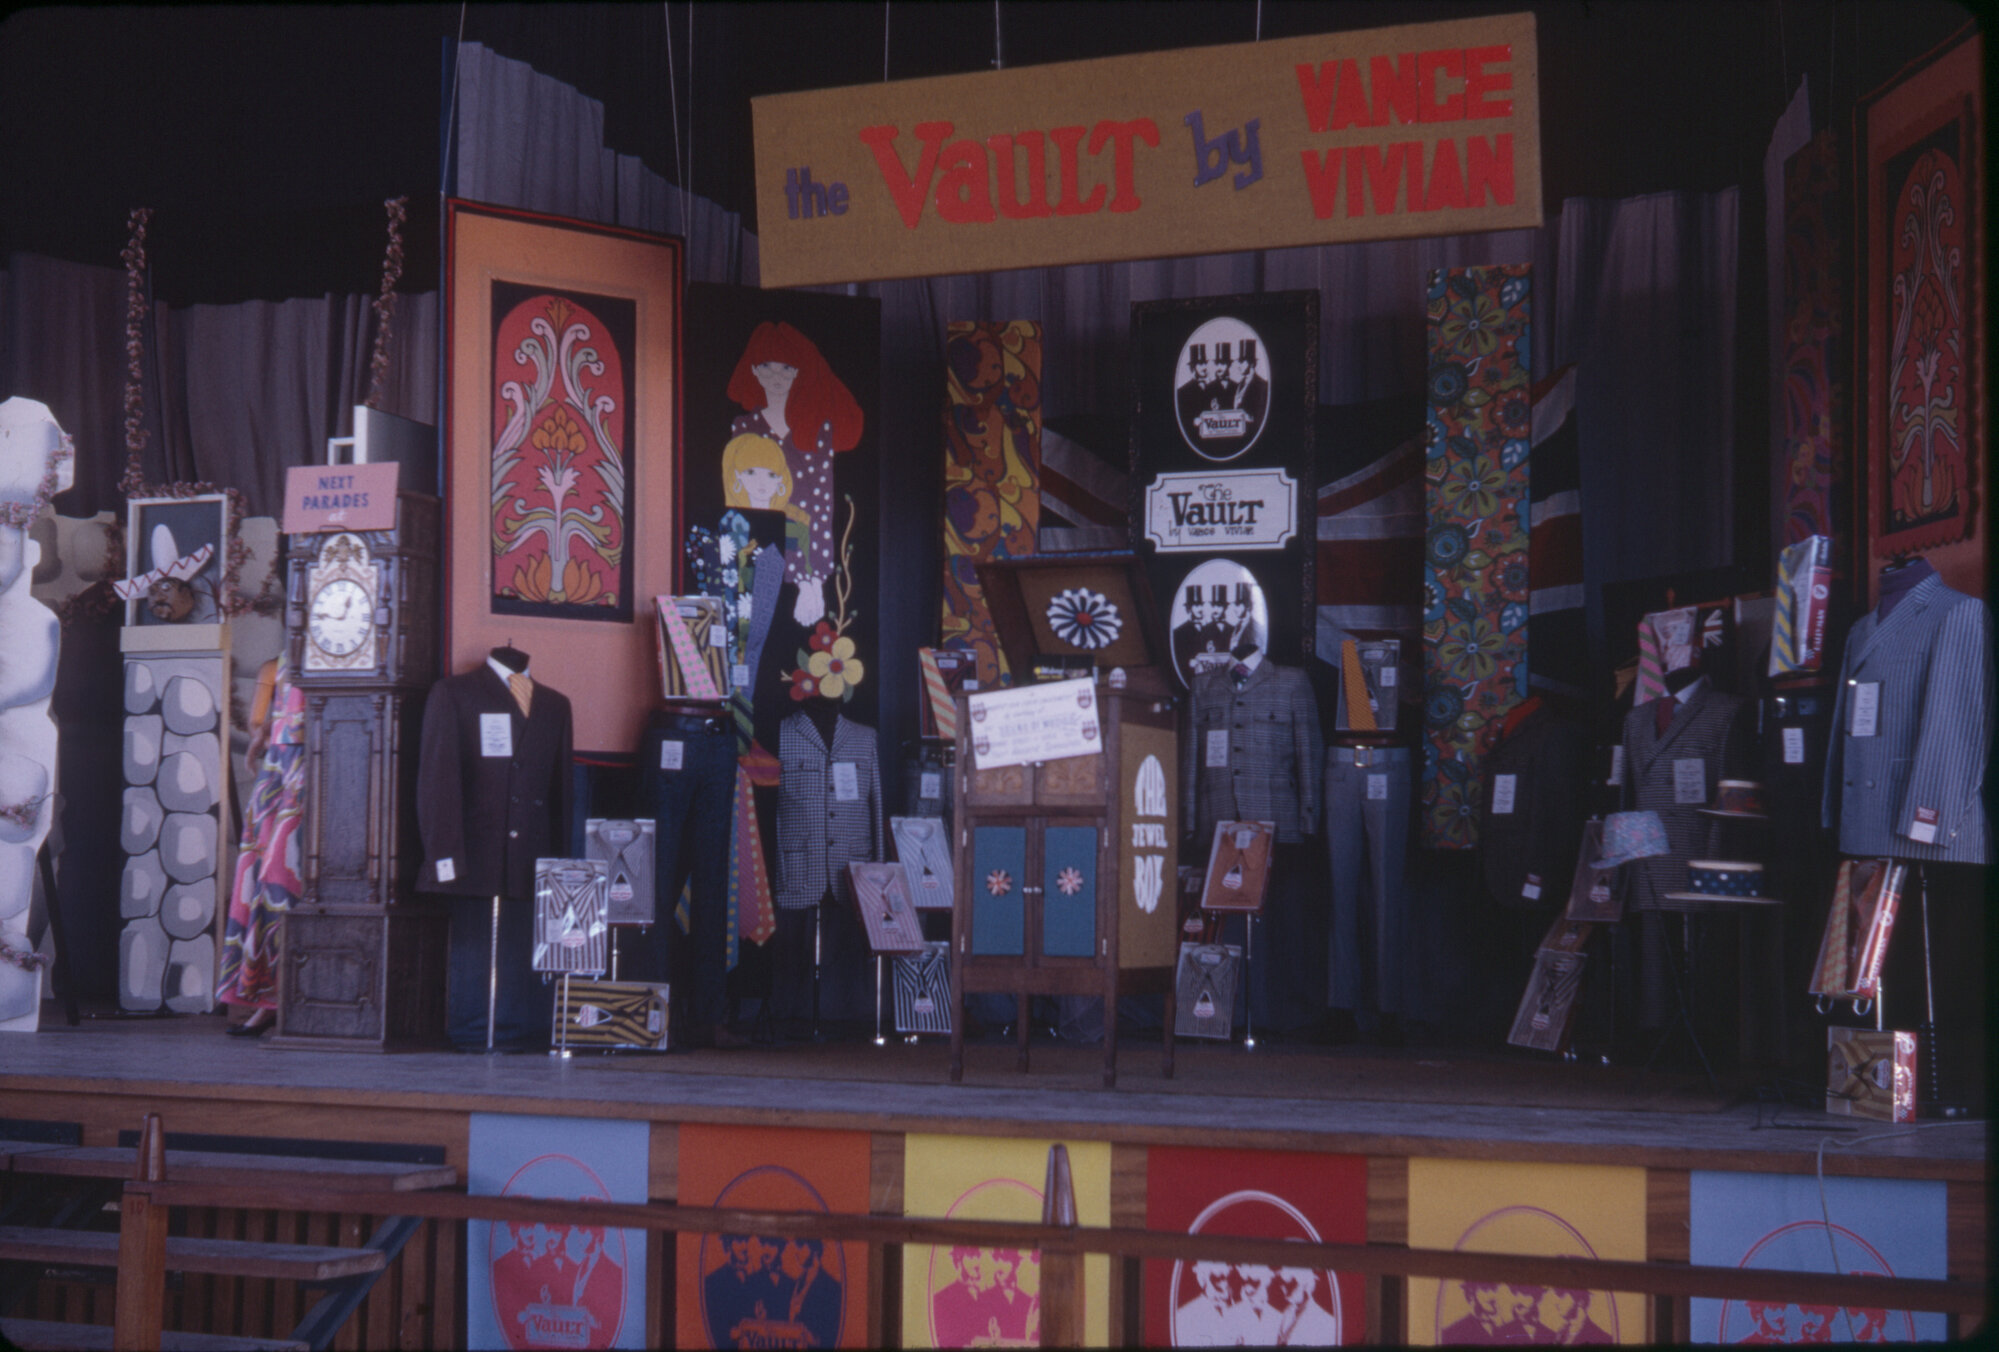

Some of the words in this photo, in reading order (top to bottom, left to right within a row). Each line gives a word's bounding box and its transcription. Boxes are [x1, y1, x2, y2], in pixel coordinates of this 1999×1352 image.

[785, 167, 849, 220] the
[1184, 111, 1264, 190] by
[1295, 44, 1513, 133] VANCE
[1300, 133, 1516, 220] VIVIAN
[318, 475, 355, 490] NEXT
[1198, 483, 1233, 501] The
[302, 493, 369, 510] PARADES
[1132, 823, 1168, 848] JEWEL
